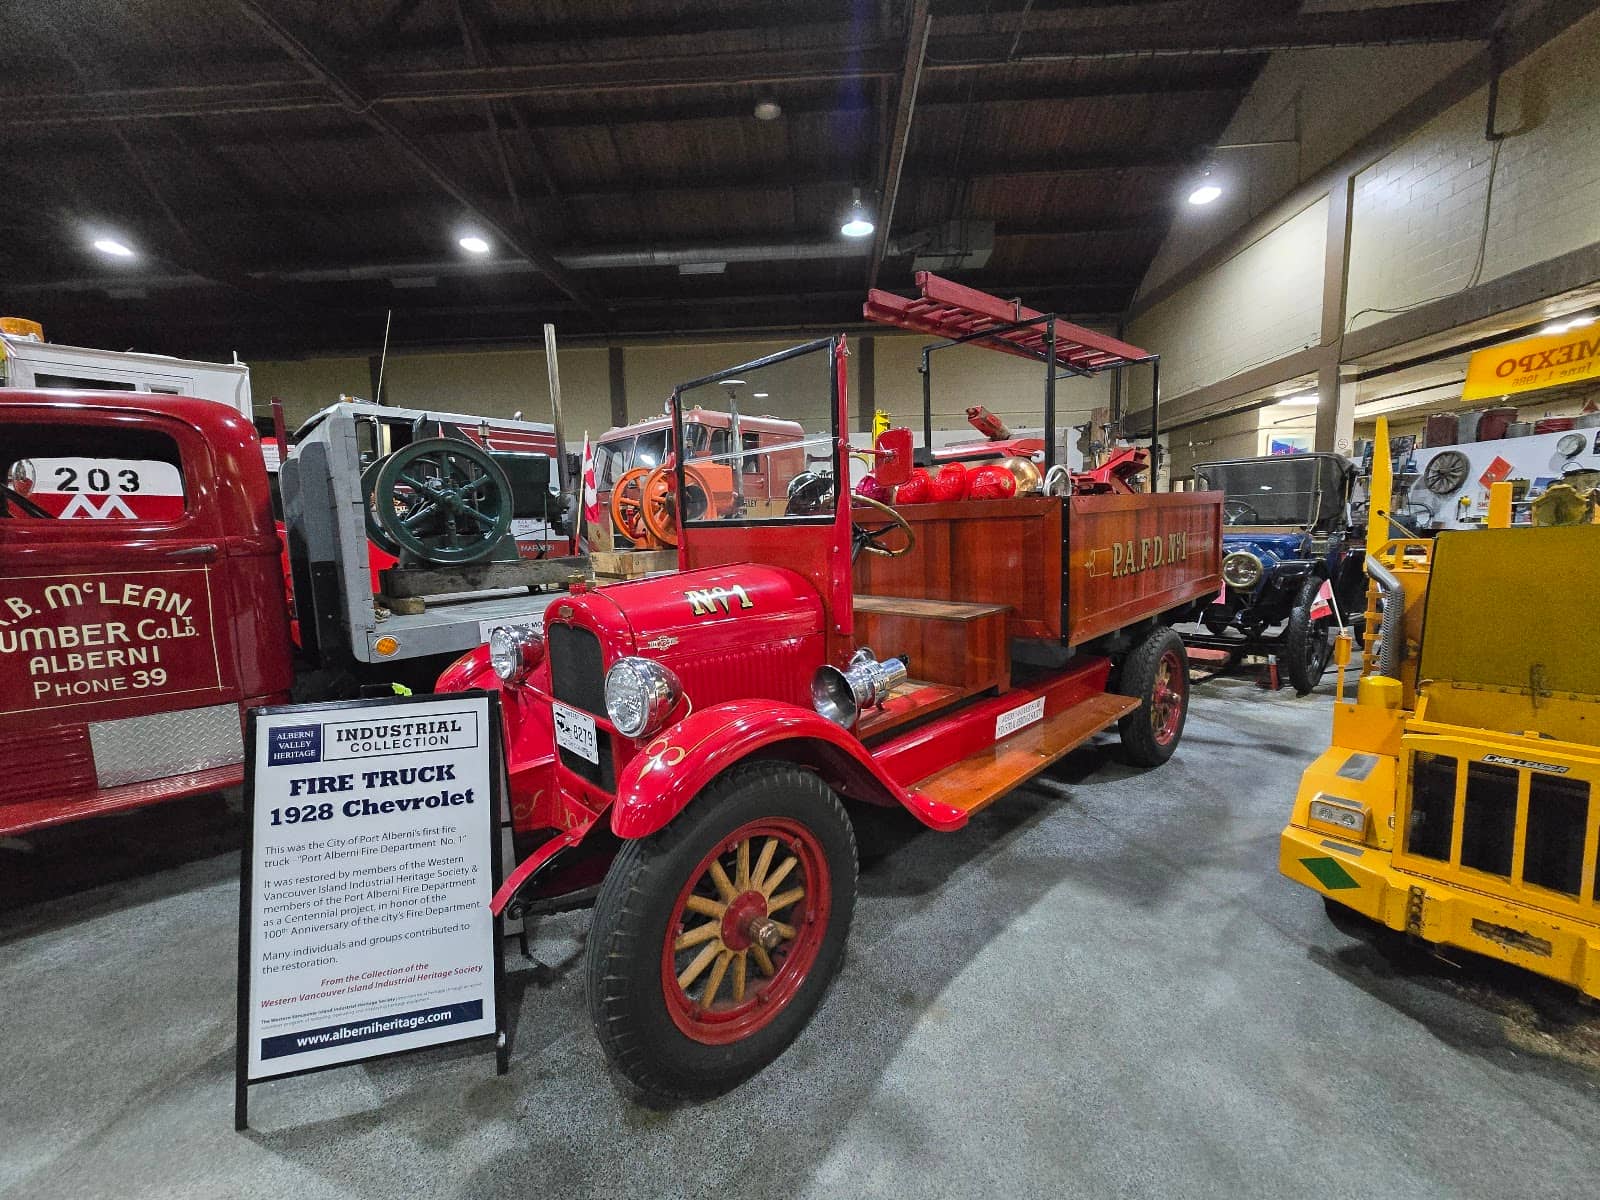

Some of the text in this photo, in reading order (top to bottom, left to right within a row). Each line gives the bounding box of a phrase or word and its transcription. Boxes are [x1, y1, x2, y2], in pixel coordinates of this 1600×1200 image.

[54, 467, 140, 493] 203
[1112, 535, 1165, 577] P.A.F.D.
[29, 645, 160, 676] ALBERNI
[132, 668, 167, 689] 39
[276, 730, 314, 741] ALBERNI
[278, 740, 312, 750] VALLEY
[336, 719, 462, 742] INDUSTRIAL
[350, 734, 449, 753] COLLECTION
[573, 724, 593, 747] 8279
[273, 749, 316, 760] HERITAGE
[289, 763, 456, 797] FIRE TRUCK
[270, 788, 475, 826] 1928 Chevrolet
[264, 857, 290, 868] truck
[324, 849, 359, 860] Alberni
[361, 847, 379, 856] Fire
[380, 840, 436, 854] Department
[440, 837, 456, 846] No.
[265, 825, 457, 855] This was the City of Port Alberni's first fire
[264, 856, 464, 889] It was restored by members of the Western
[264, 864, 478, 901] Vancouver Island Industrial Heritage Society &
[263, 878, 476, 915] members of the Port Alberni Fire Department
[263, 919, 274, 927] as
[284, 908, 338, 924] Centennial
[379, 902, 387, 910] in
[390, 899, 418, 908] honor
[420, 895, 430, 904] of
[431, 893, 447, 902] the
[290, 918, 349, 936] Anniversary
[351, 917, 361, 926] of
[363, 915, 379, 924] the
[381, 911, 404, 921] city's
[406, 909, 423, 918] Fire
[425, 901, 481, 915] Department
[262, 922, 471, 962] Many individuals and groups contributed to
[262, 956, 338, 975] the restoration.
[320, 962, 429, 987] From the Collection of the
[261, 963, 483, 1008] Western Vancouver Island Industrial Heritage Society
[296, 1009, 452, 1048] www.alberniheritage.com
